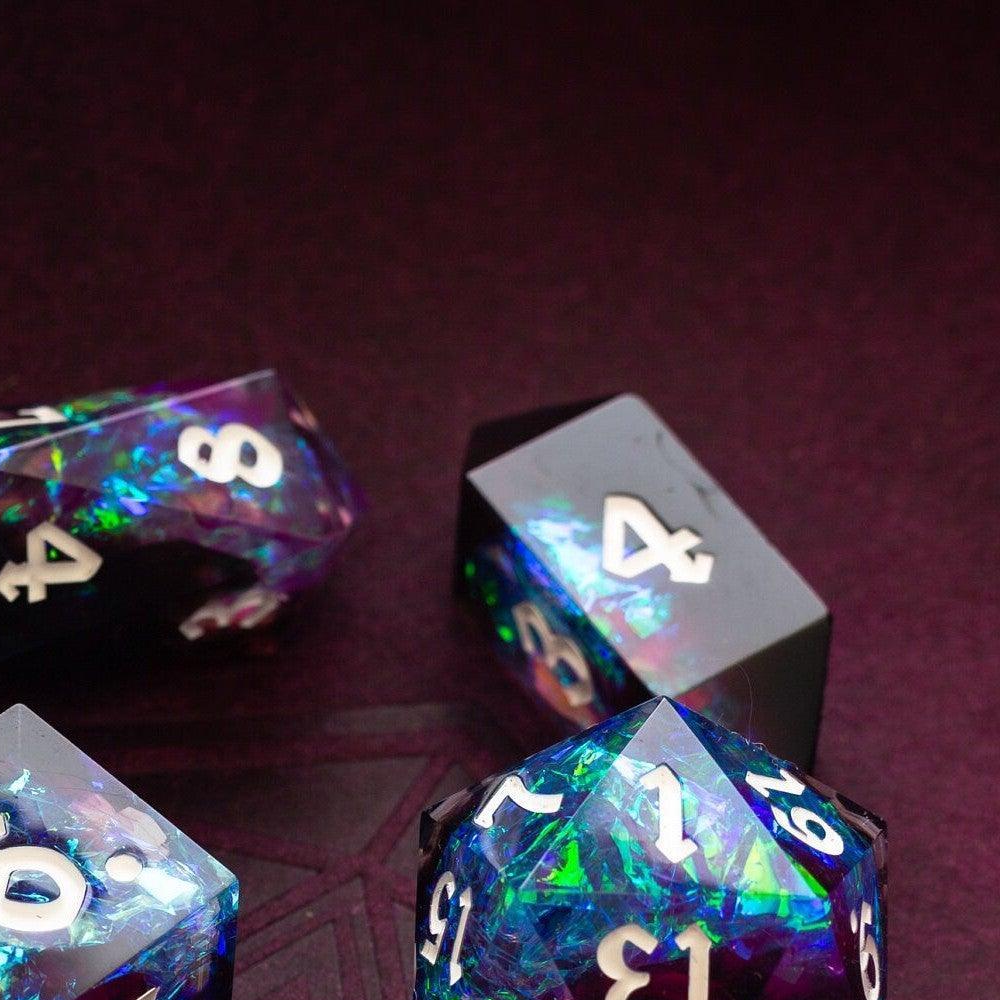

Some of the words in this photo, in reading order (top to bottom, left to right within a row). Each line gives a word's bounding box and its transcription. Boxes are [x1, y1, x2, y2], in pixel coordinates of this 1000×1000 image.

[177, 422, 283, 488] 8
[603, 490, 715, 585] 4
[472, 774, 564, 829] 7
[638, 762, 699, 864] 1
